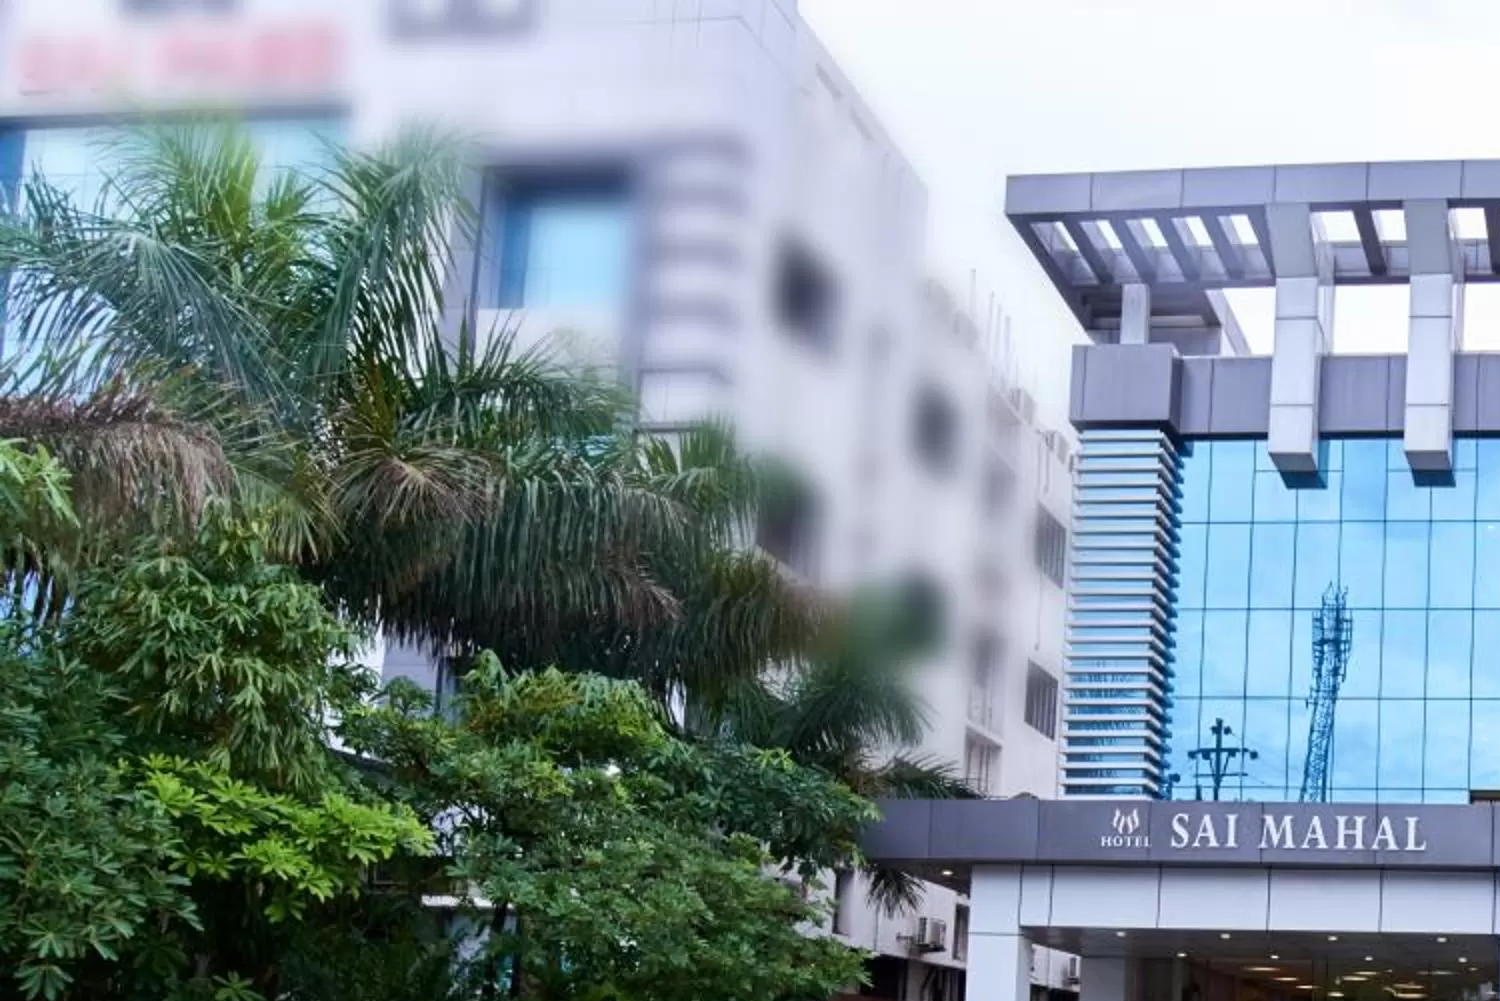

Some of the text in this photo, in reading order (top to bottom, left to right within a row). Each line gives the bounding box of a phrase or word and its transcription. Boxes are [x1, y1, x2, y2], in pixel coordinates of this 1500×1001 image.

[1101, 813, 1427, 851] HOTEL SAI MAHAL
